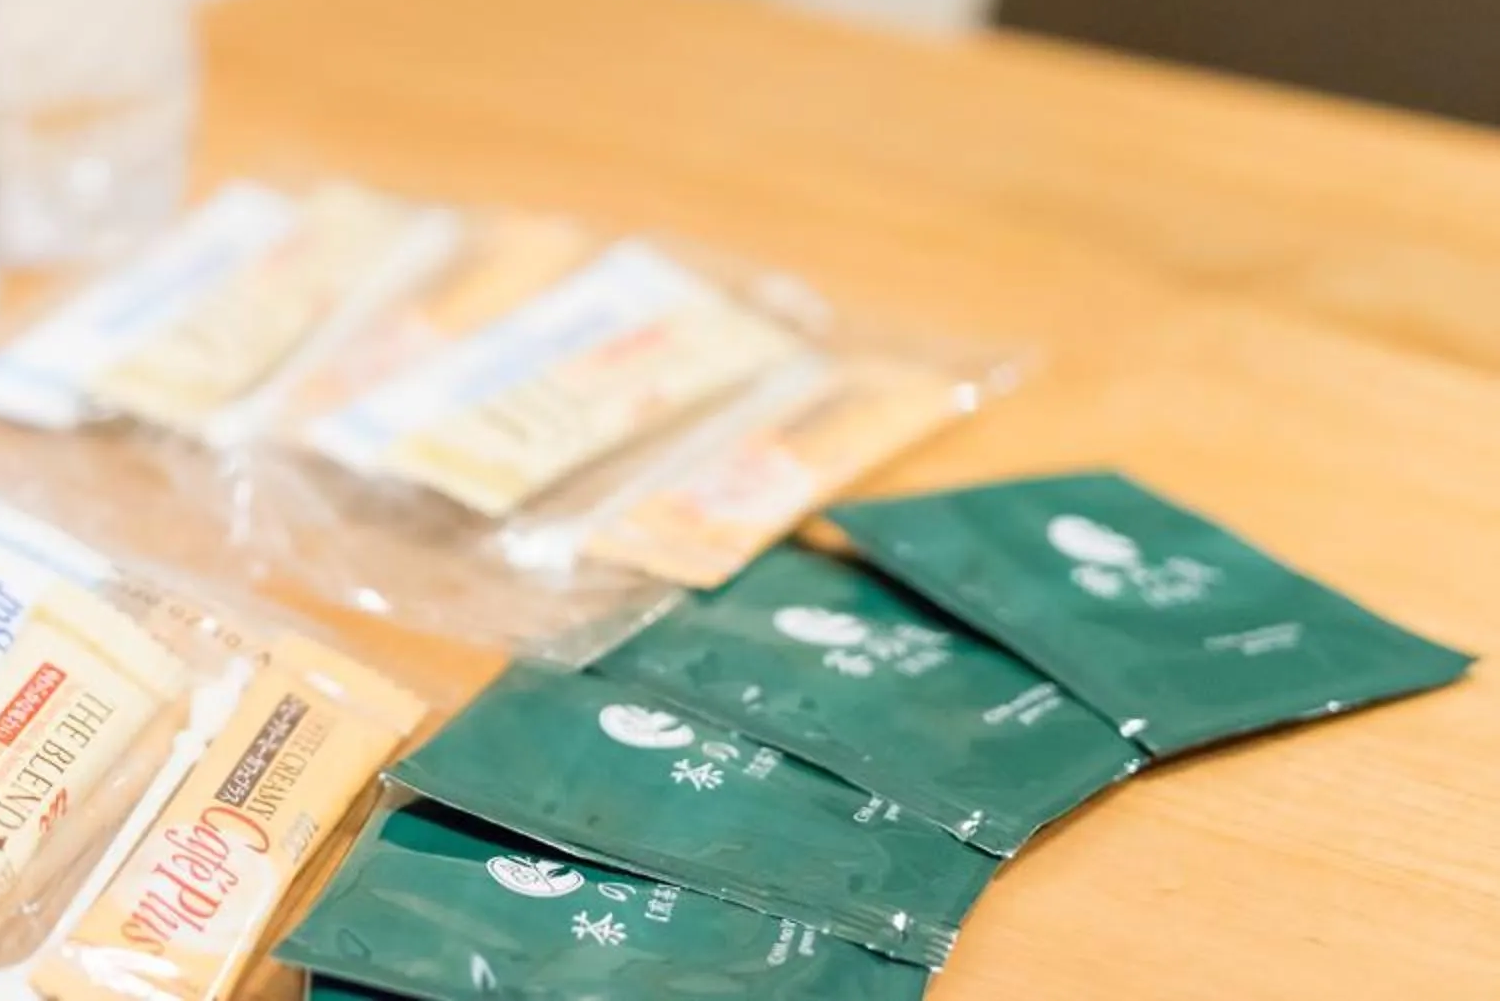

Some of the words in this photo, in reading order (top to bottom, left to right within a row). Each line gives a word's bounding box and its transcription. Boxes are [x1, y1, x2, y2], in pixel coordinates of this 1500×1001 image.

[54, 691, 115, 751] THE
[670, 739, 740, 791] 茶の
[571, 881, 637, 946] 茶の
